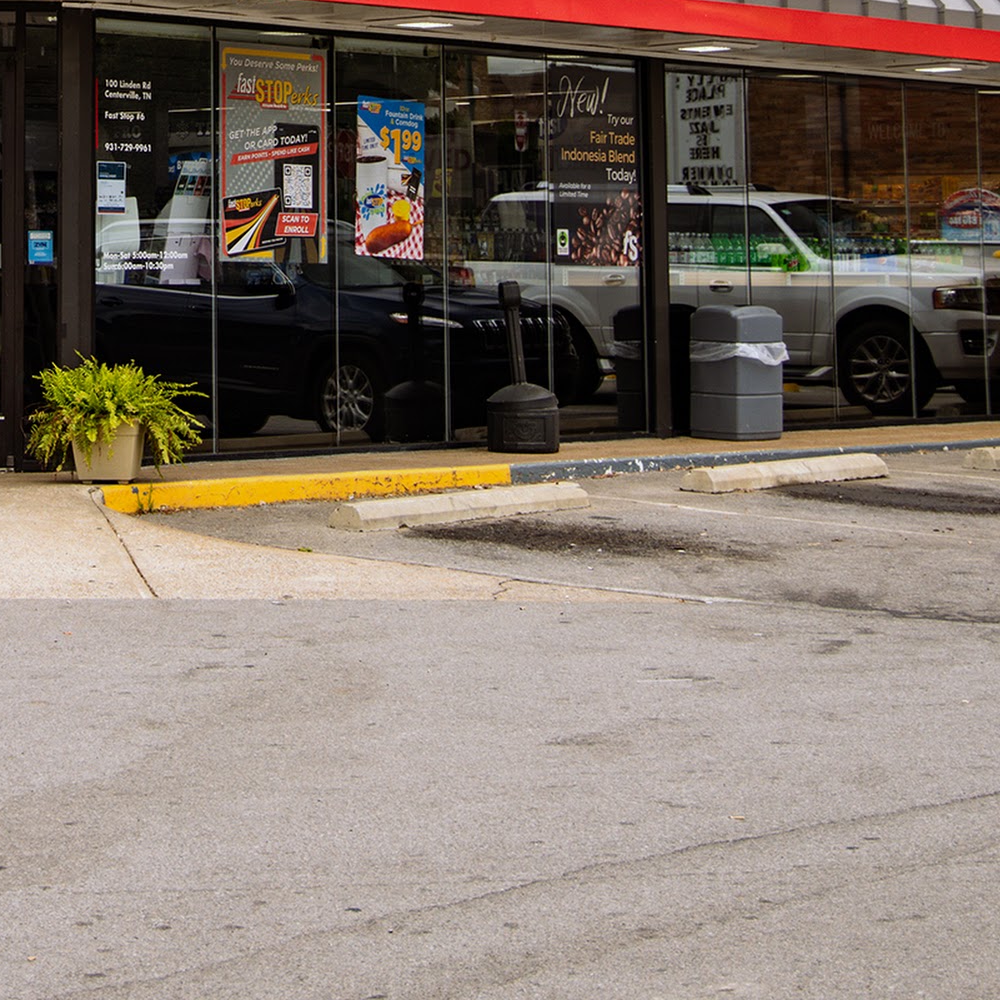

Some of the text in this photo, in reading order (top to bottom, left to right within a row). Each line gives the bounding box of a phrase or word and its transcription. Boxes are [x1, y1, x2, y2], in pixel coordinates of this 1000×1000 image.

[229, 57, 319, 73] You Deserve Some Perks!
[105, 79, 152, 90] 100 Linden Rd
[104, 90, 152, 101] Centerville, TN
[557, 75, 609, 118] New!
[104, 111, 119, 120] Fast
[120, 112, 135, 122] Stop
[385, 110, 424, 121] Fountain Drink
[607, 113, 634, 127] Try our
[229, 125, 278, 140] GET THE APP
[590, 130, 636, 146] Fair Trade
[104, 142, 152, 152] 931-729-9961
[244, 133, 308, 151] OR CARD TODAY!
[251, 152, 268, 160] POINTS
[561, 147, 636, 163] Indonesia Blend
[605, 168, 637, 184] Today!
[282, 215, 310, 223] SCAN TO
[284, 226, 309, 234] ENROLL
[103, 250, 131, 260] Mon-Sat
